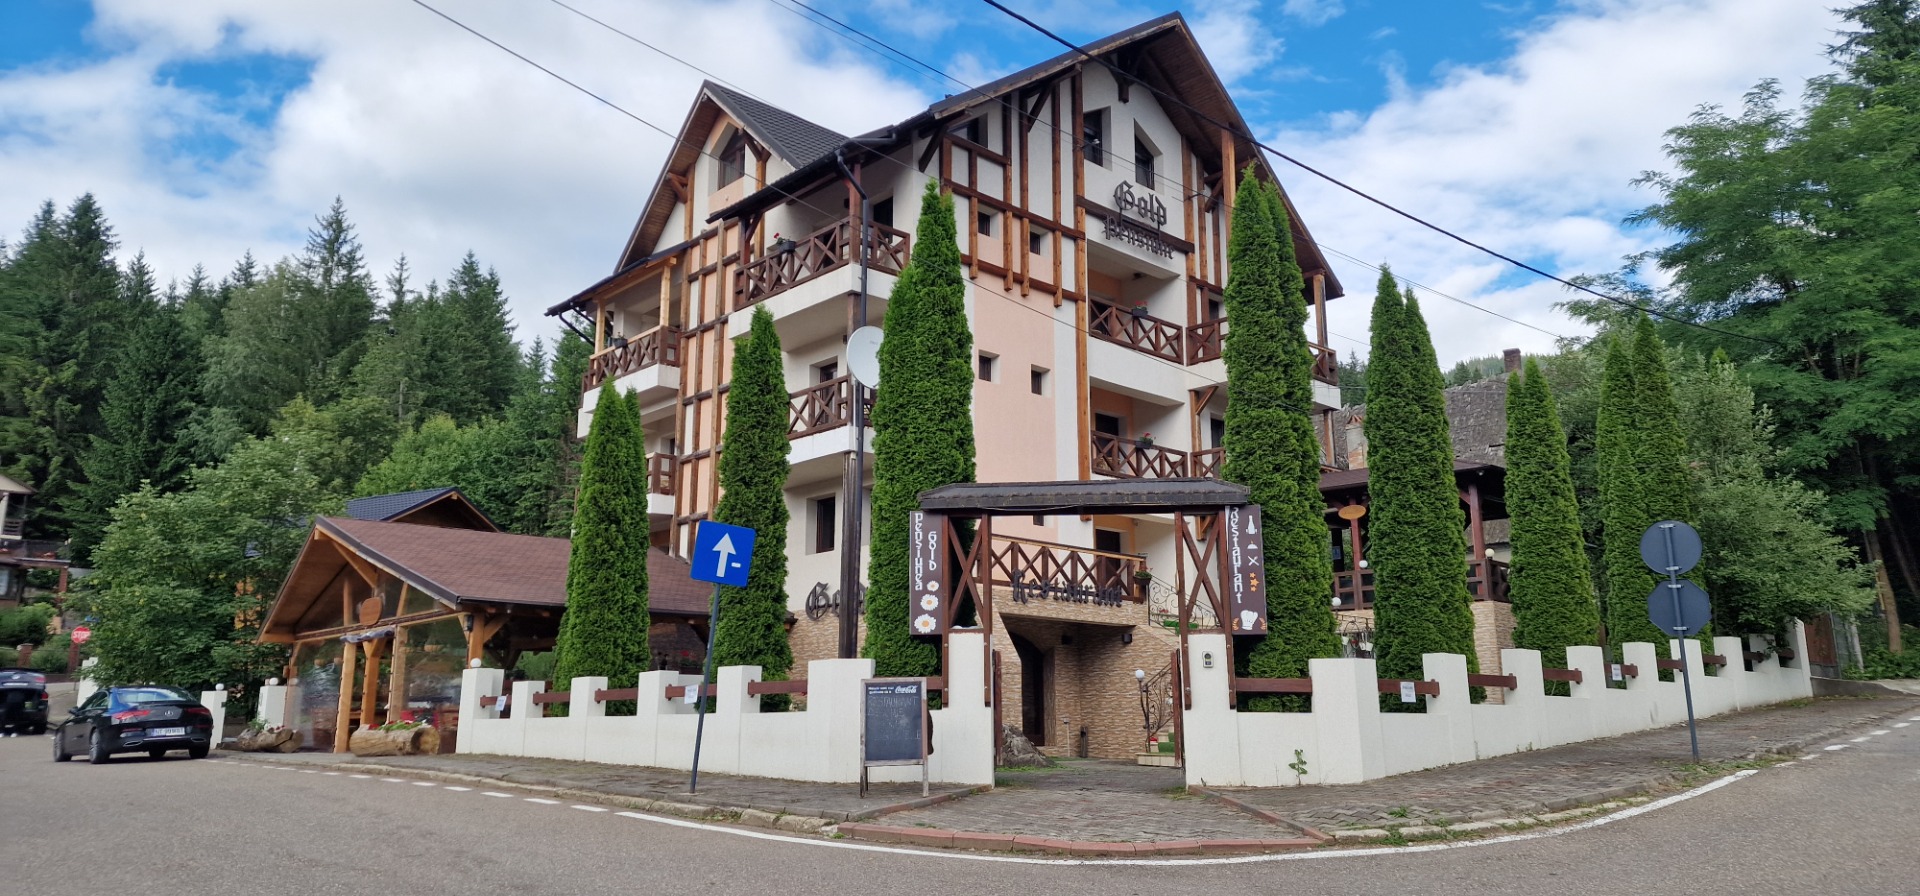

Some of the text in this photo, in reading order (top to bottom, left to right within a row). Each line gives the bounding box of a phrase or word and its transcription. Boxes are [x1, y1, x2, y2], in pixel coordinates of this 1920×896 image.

[914, 512, 924, 591] Pensiunea
[1230, 507, 1244, 604] Restaurant
[72, 630, 91, 640] STOP
